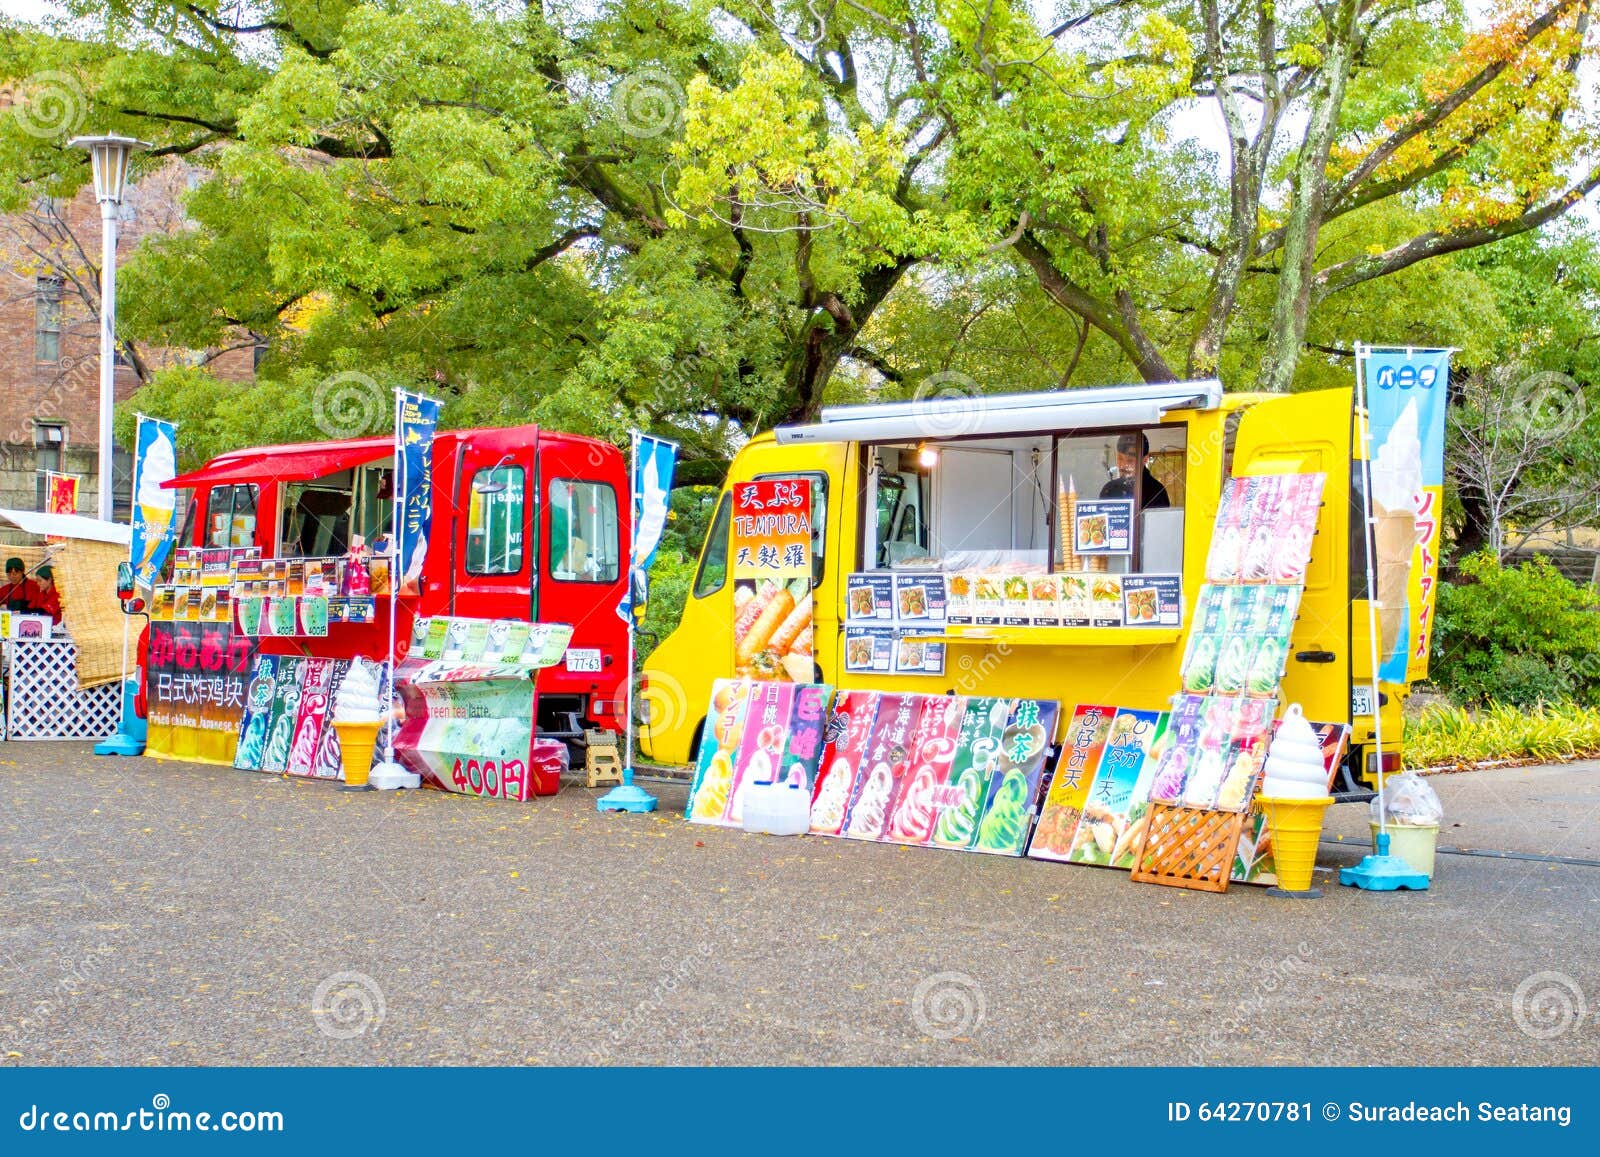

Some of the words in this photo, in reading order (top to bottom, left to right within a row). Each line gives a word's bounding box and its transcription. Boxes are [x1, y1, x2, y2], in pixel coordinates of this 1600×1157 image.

[1378, 366, 1437, 388] バニラ
[407, 494, 422, 535] バニラ
[734, 512, 810, 537] TEMPURA
[1413, 493, 1434, 658] ソフトアイス
[150, 627, 252, 672] からあげ
[158, 673, 243, 708] 日式炸鸡块
[254, 658, 274, 706] 抹茶
[453, 707, 467, 718] tea
[889, 695, 913, 745] 北海道
[1008, 700, 1041, 765] 抹茶
[1061, 709, 1101, 790] お好み天
[452, 757, 526, 801] 400円
